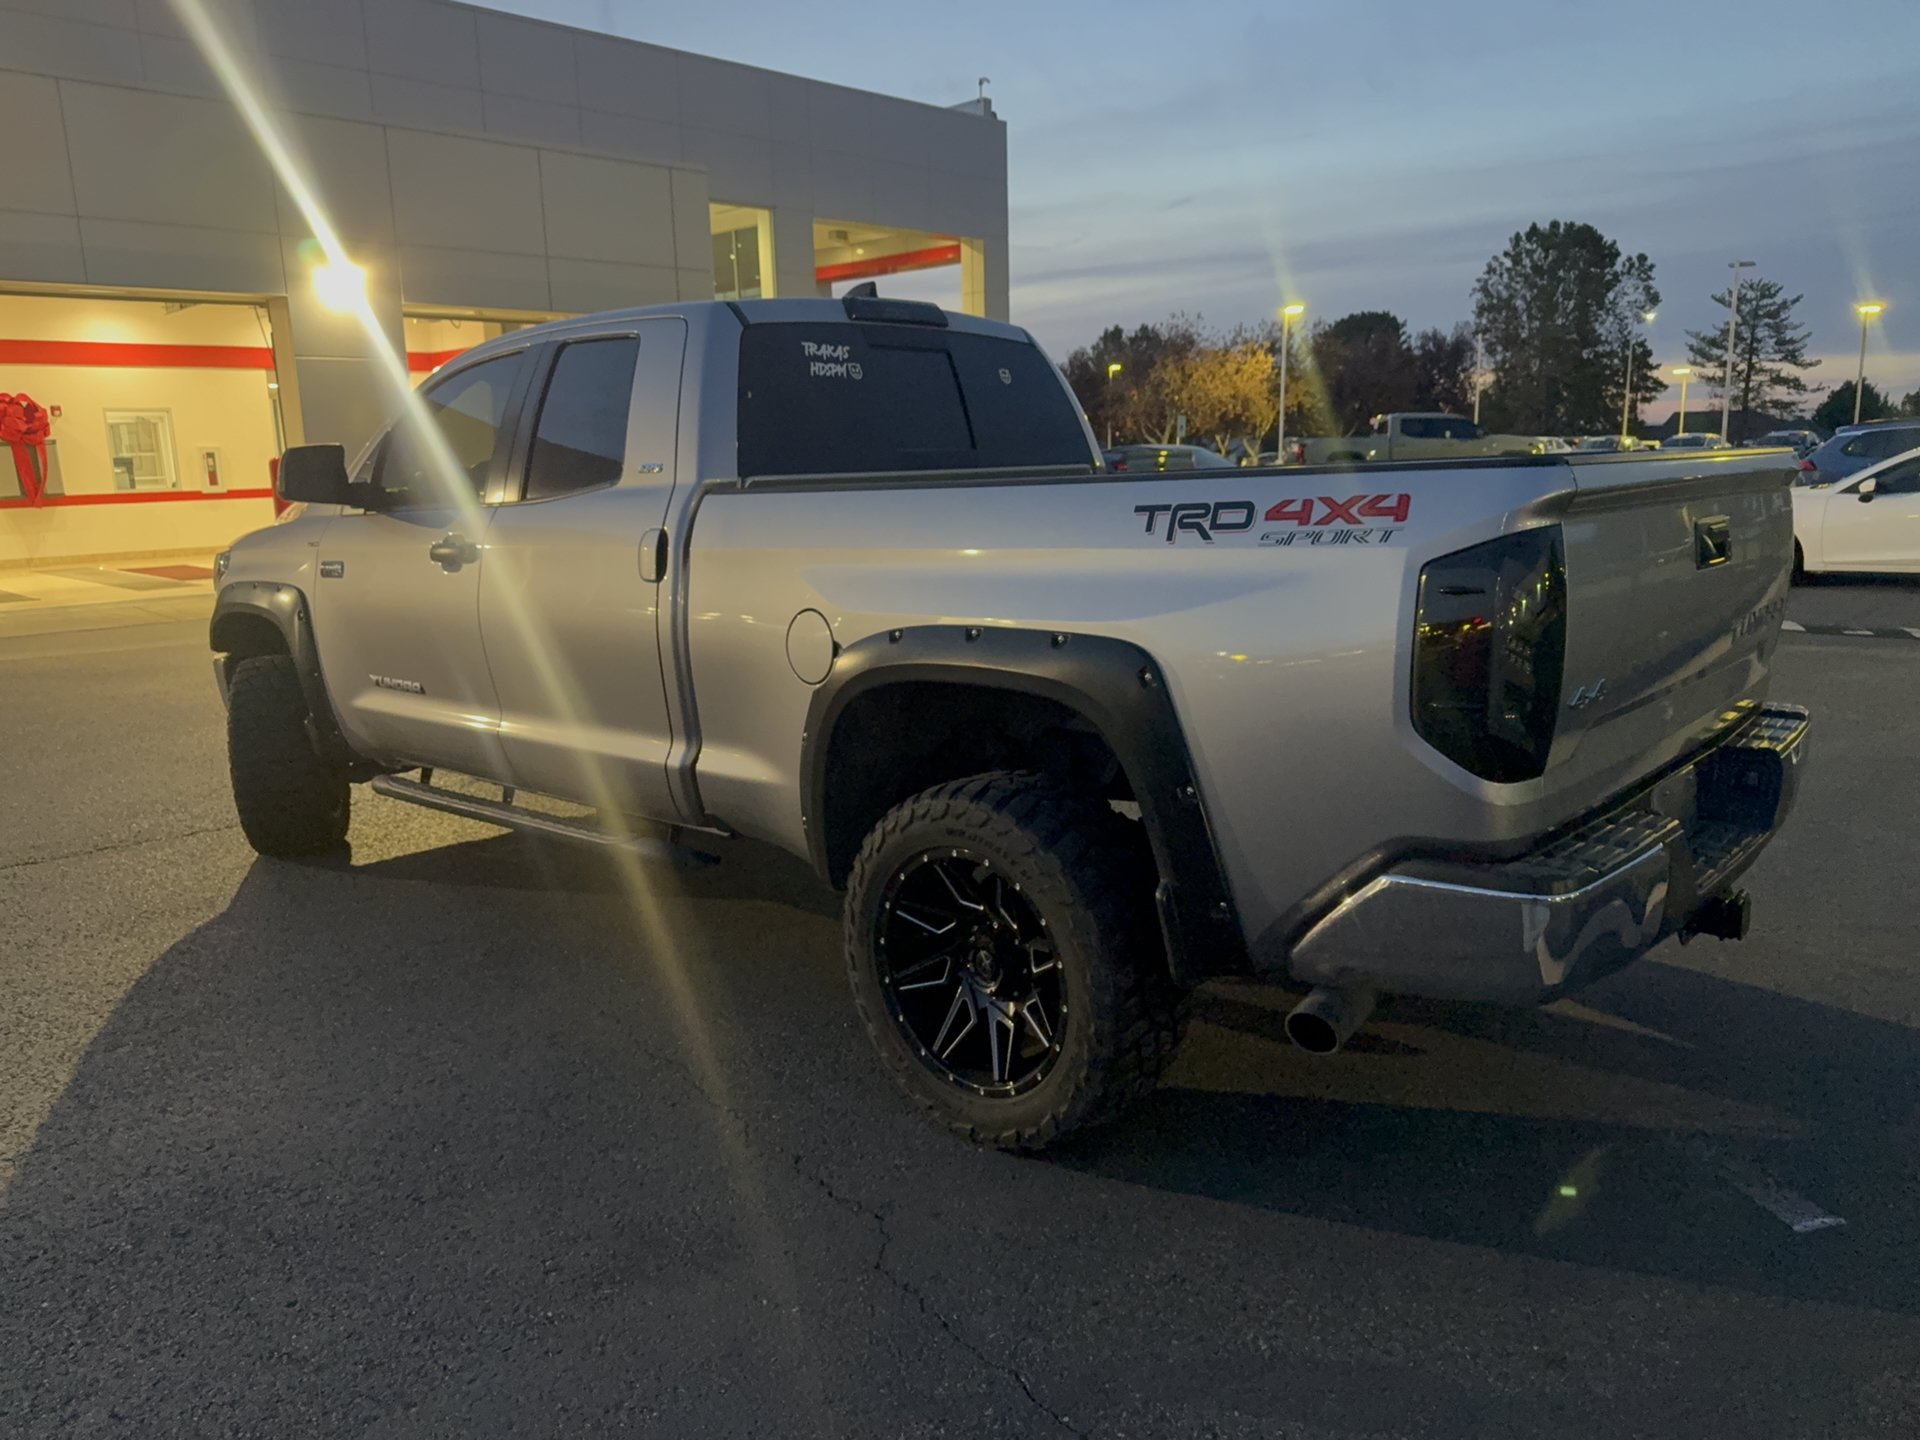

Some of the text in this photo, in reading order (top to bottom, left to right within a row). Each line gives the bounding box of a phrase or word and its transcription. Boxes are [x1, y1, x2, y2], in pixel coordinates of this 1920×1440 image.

[1134, 493, 1411, 544] TRD 4X4
[1259, 526, 1404, 547] SPORT
